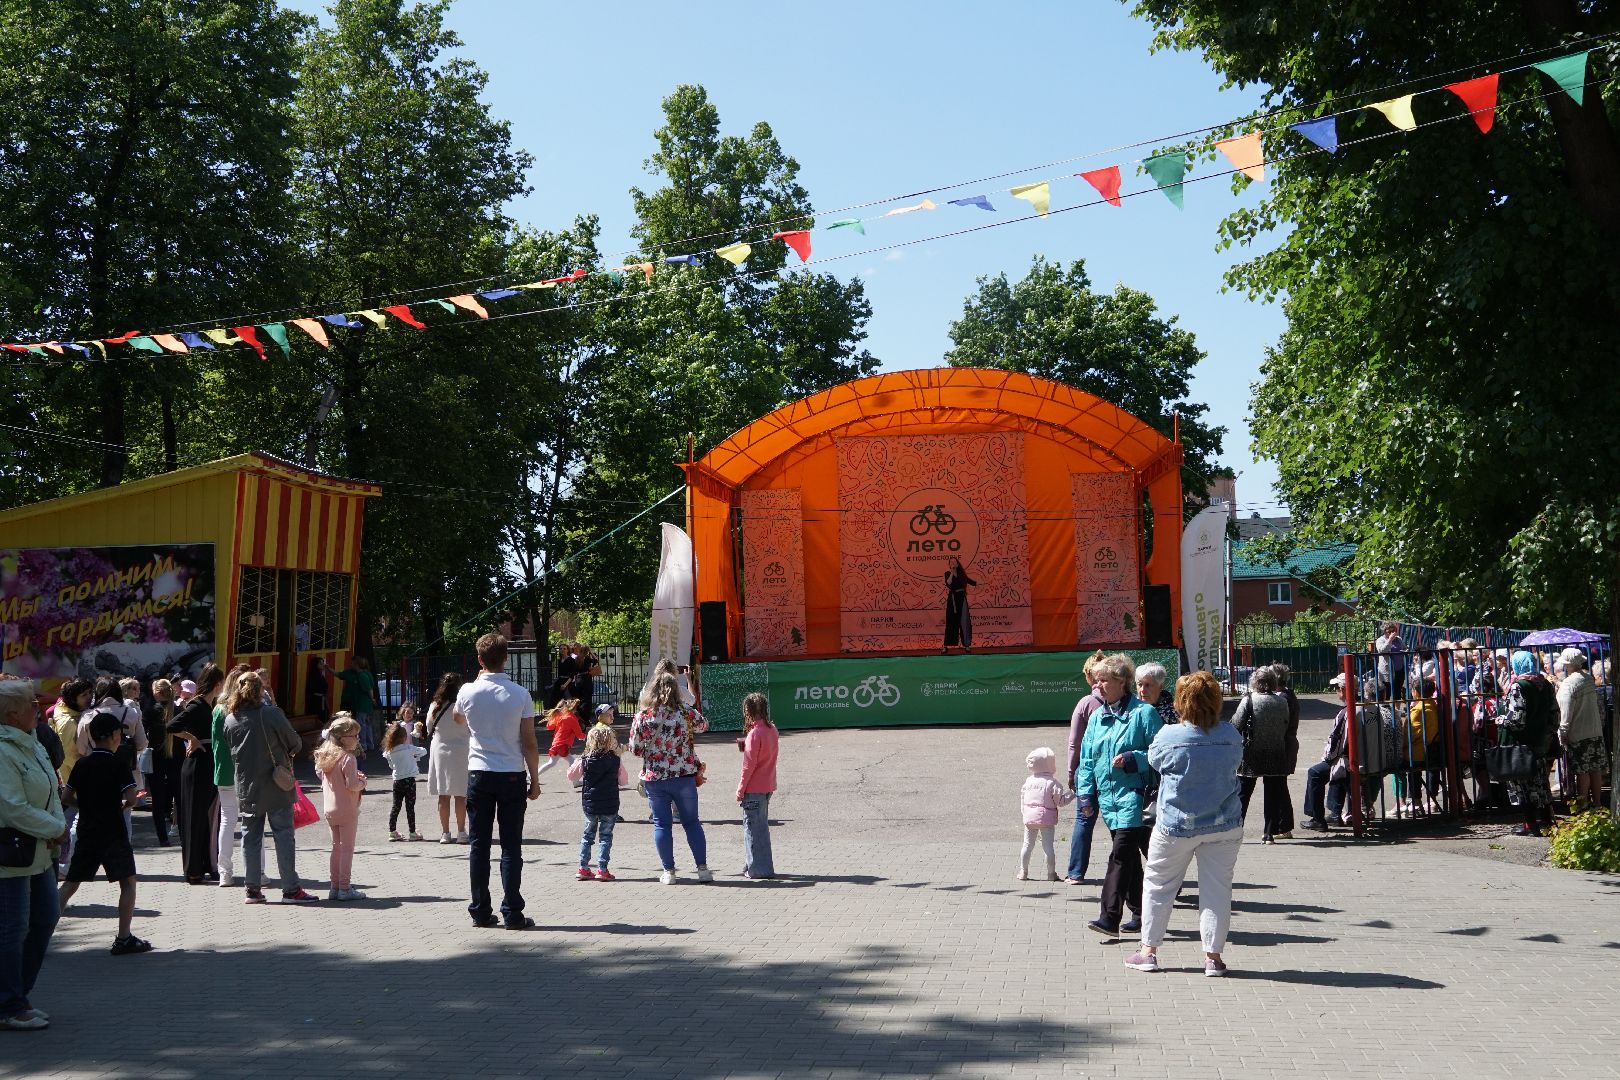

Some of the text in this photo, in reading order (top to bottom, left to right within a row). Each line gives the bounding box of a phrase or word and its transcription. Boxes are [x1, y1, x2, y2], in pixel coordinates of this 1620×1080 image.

[906, 538, 961, 553] лето
[1093, 561, 1119, 569] лето
[762, 577, 787, 585] лето
[1194, 592, 1208, 671] орошего
[794, 685, 850, 700] лето
